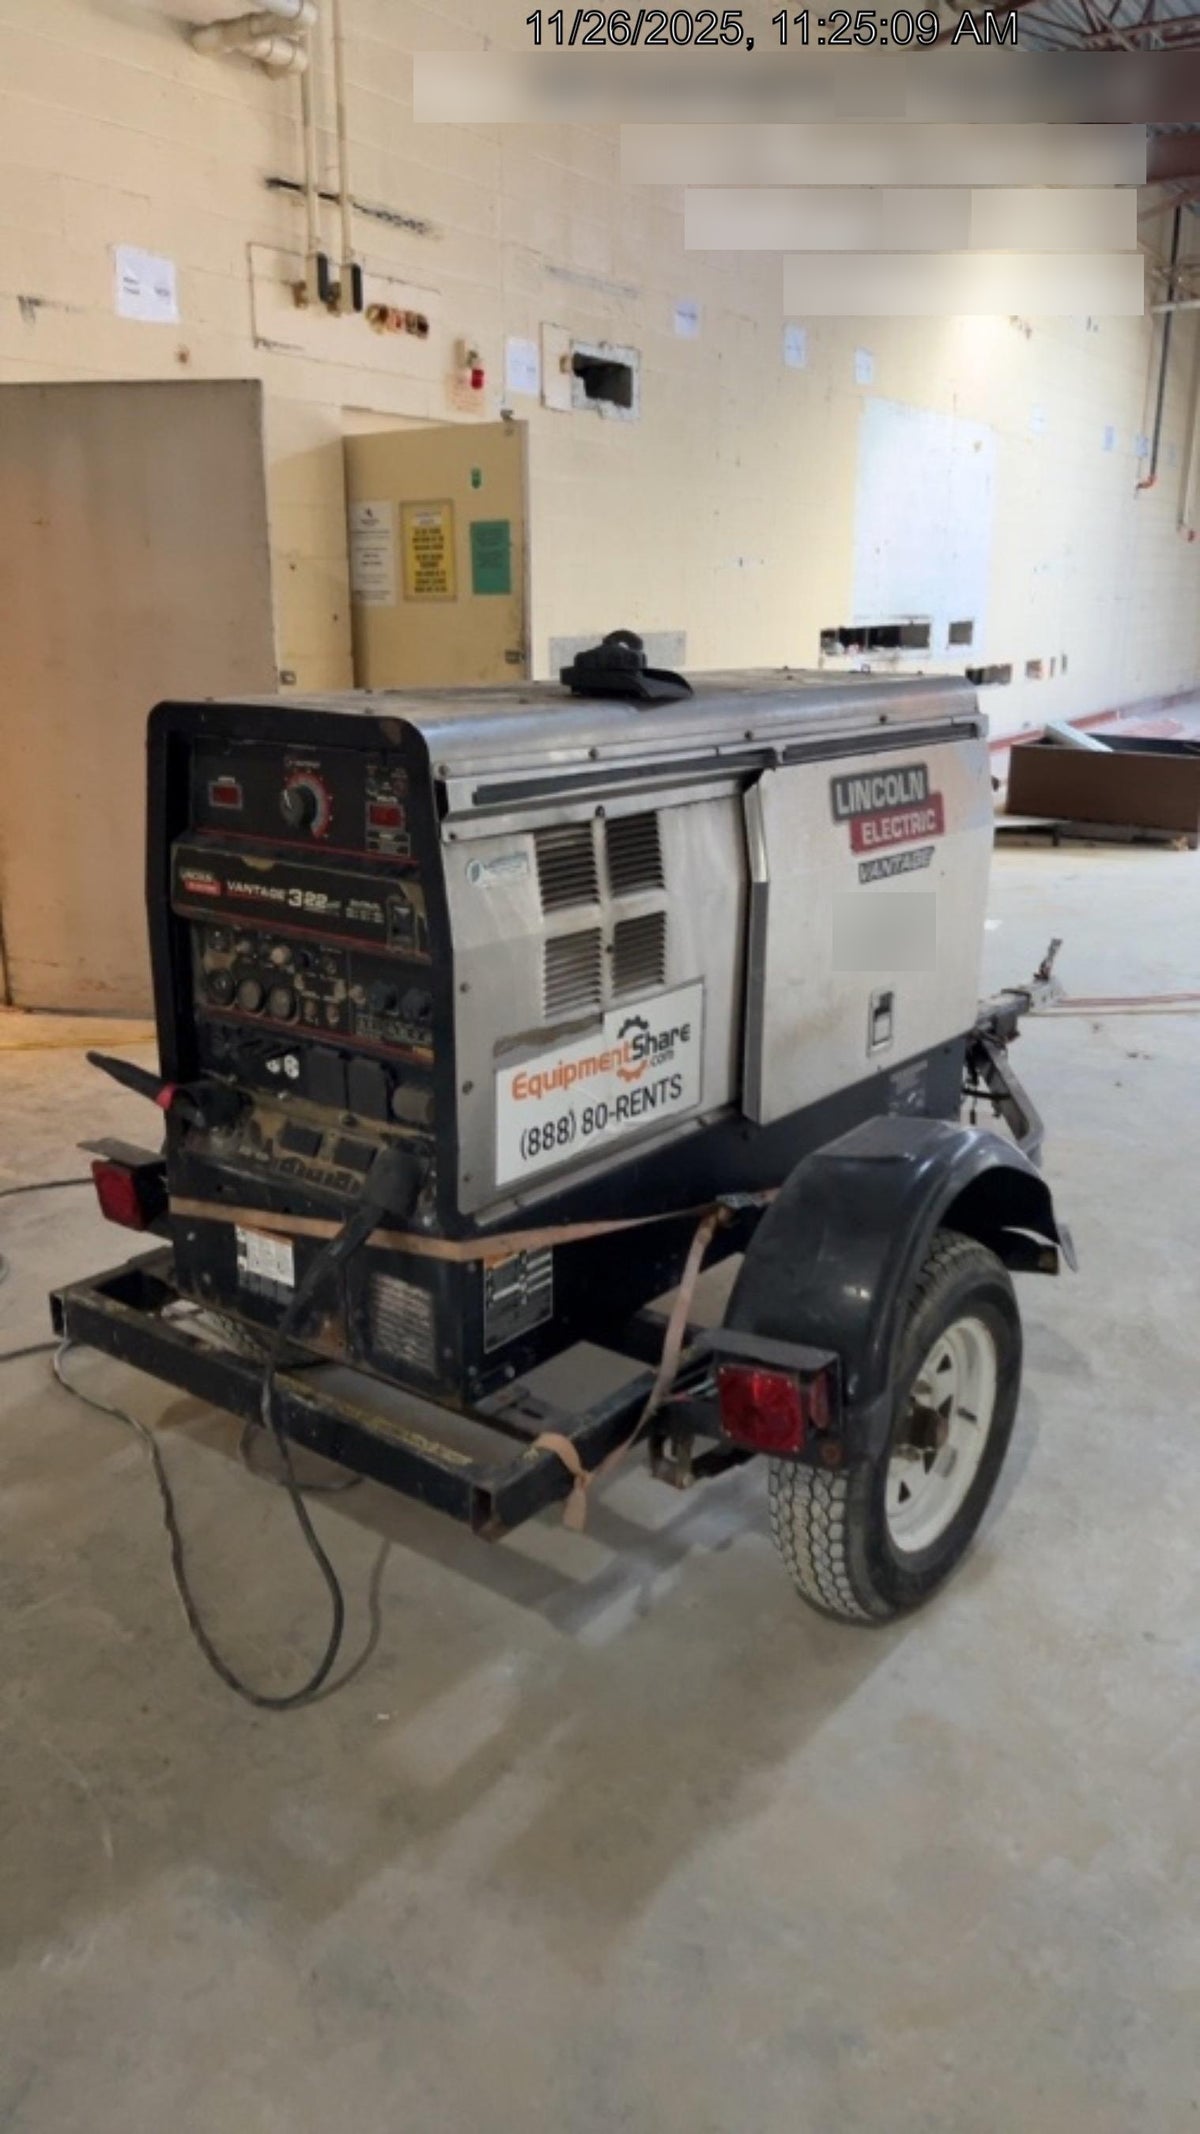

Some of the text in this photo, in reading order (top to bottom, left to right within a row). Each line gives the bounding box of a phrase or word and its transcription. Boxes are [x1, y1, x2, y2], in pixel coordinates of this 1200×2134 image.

[835, 769, 925, 815] LINCOLN
[861, 808, 936, 845] ELECTRIC
[858, 845, 935, 884] VANTAGE
[512, 1023, 691, 1101] EquipmentShare
[520, 1073, 683, 1161] (888) 80-RENTS
